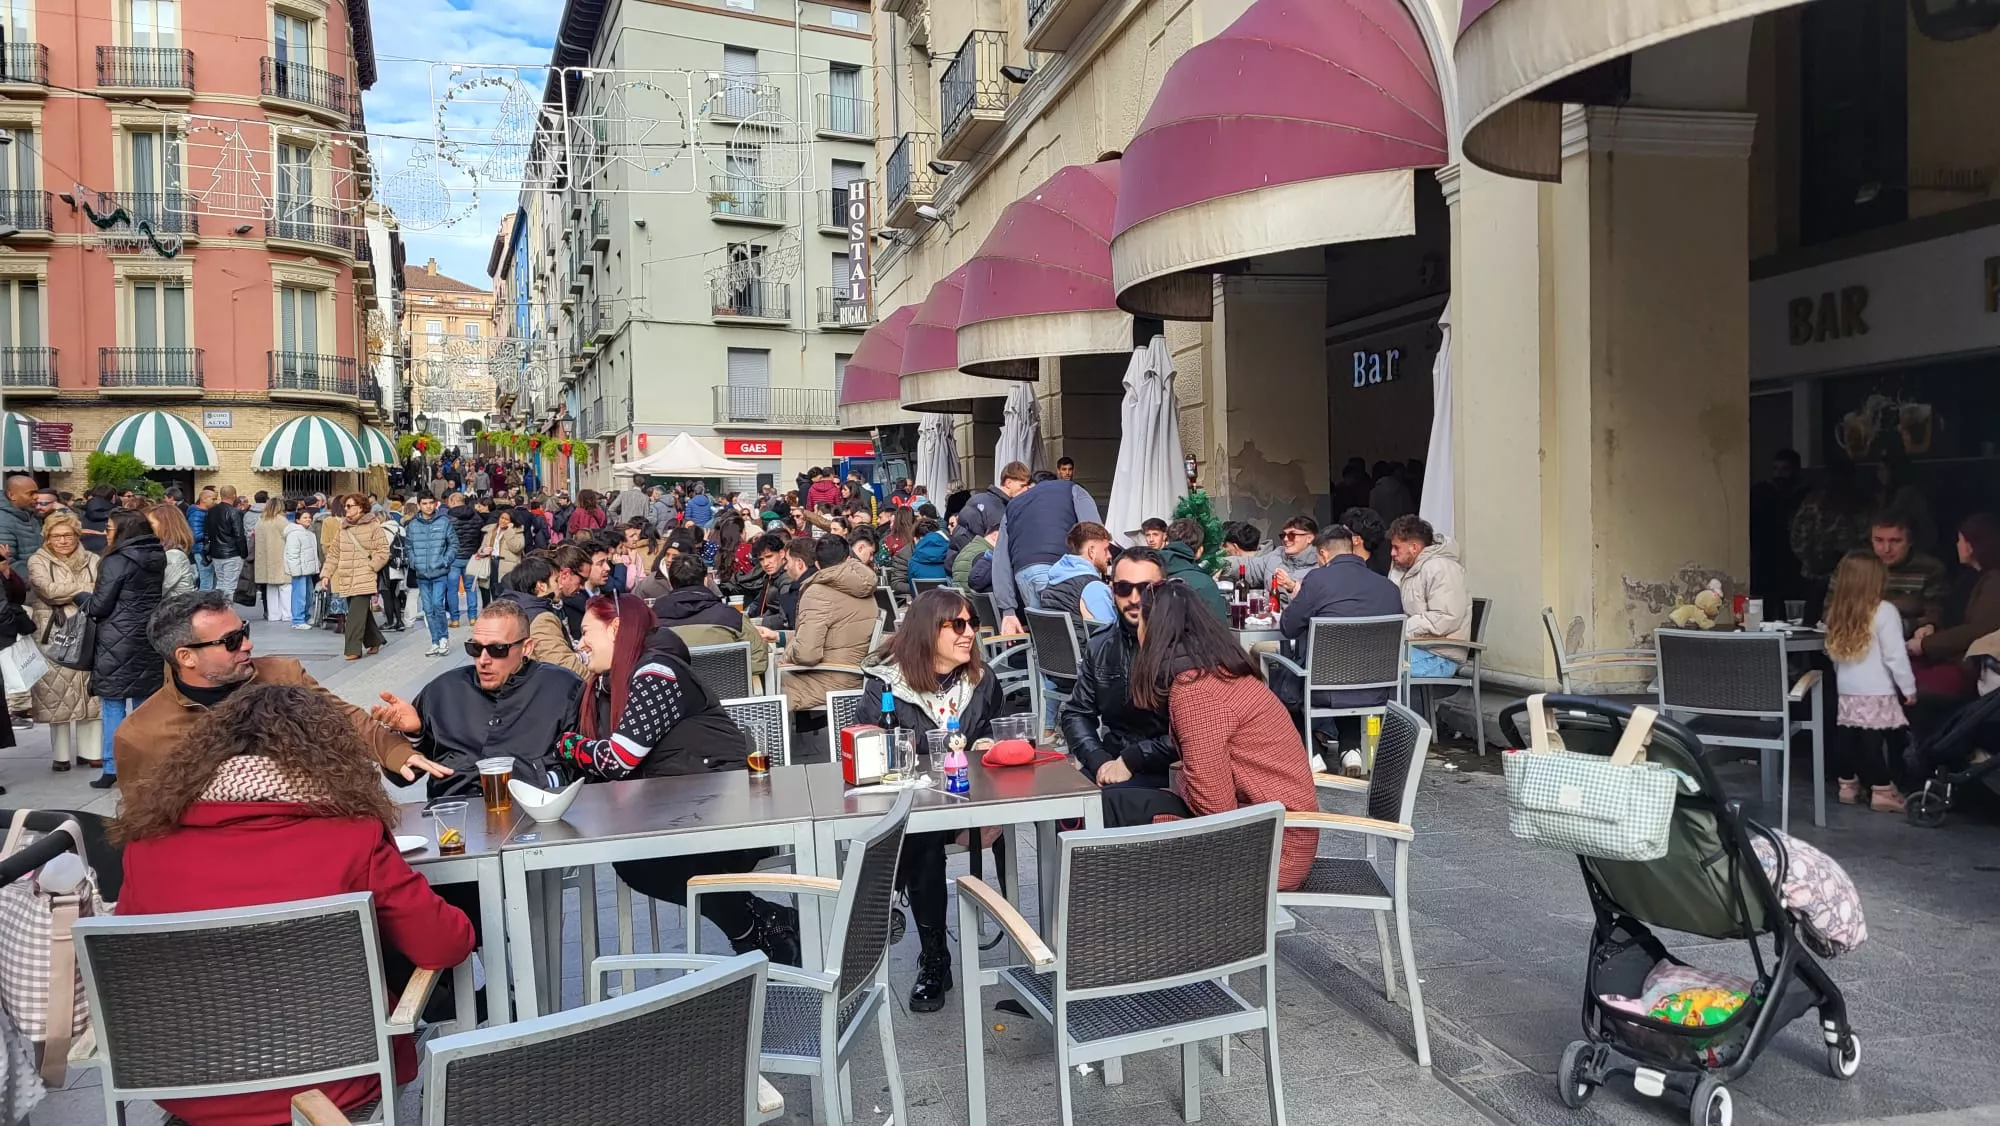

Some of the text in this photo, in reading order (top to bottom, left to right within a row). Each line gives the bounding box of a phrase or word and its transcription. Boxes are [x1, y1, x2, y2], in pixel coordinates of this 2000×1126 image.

[849, 182, 866, 300] HOSTAL
[840, 305, 867, 325] RUGACA
[1788, 285, 1870, 346] BAR
[1352, 348, 1400, 388] Bar
[740, 443, 767, 453] GAES
